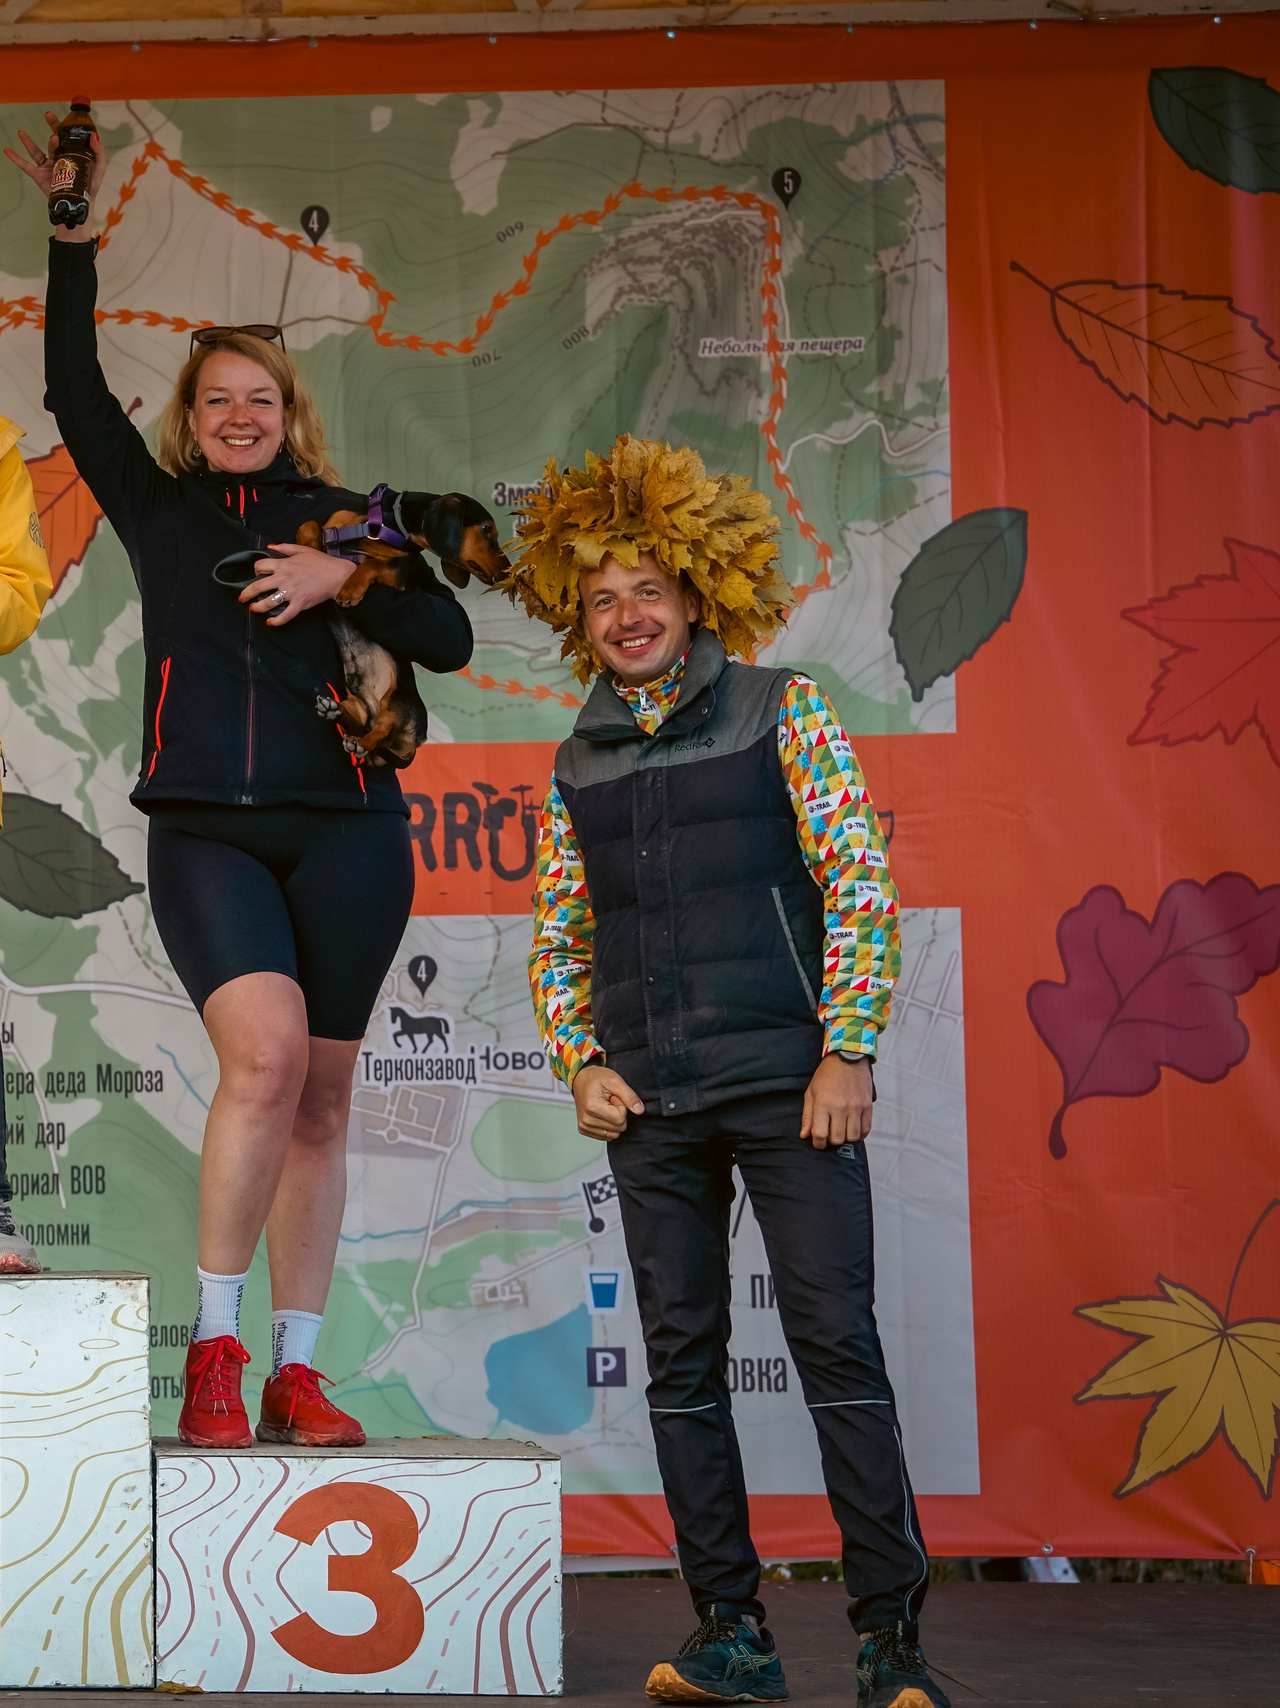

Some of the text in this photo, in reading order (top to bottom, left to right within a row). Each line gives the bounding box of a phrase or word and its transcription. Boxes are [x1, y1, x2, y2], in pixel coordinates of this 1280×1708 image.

[782, 171, 794, 195] 5
[308, 210, 320, 234] 4
[800, 338, 864, 353] пещера
[416, 960, 427, 982] 4
[44, 1070, 86, 1097] деда
[96, 1063, 164, 1099] Мороза
[361, 1051, 477, 1087] Терконзавод
[35, 1122, 66, 1150] дар
[6, 1164, 106, 1201] ориал ВОВ
[20, 1223, 91, 1246] оломни
[273, 1482, 422, 1674] 3
